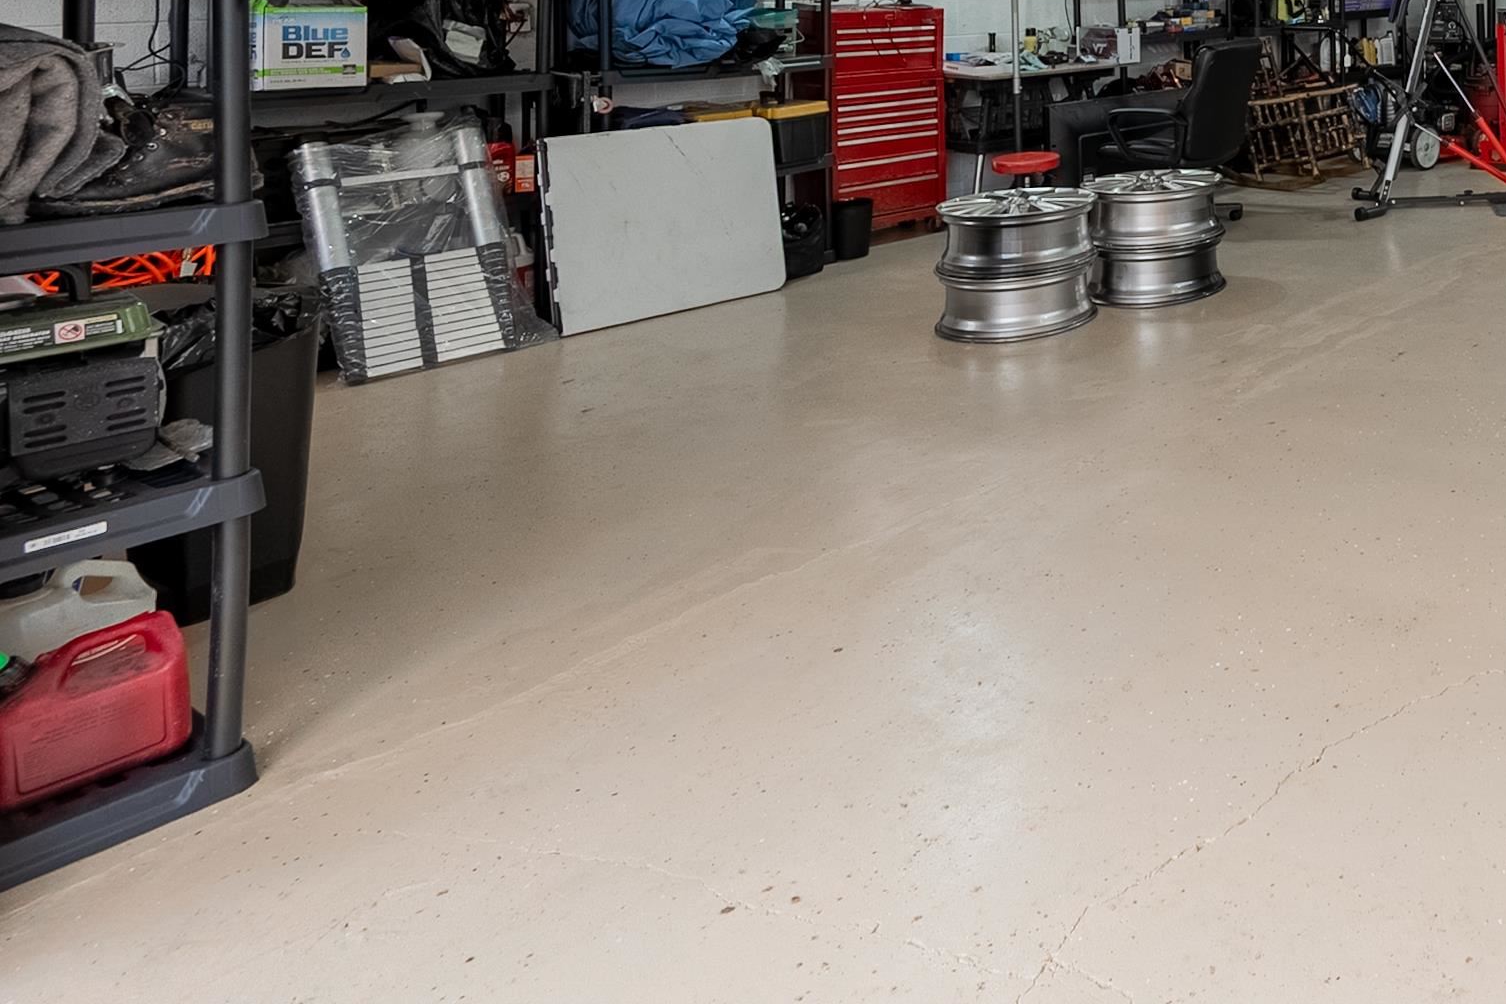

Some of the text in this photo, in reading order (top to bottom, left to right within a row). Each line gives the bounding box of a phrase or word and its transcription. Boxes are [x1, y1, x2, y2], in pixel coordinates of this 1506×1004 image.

[282, 25, 349, 42] Blue
[282, 42, 349, 60] DEF
[1092, 43, 1108, 55] VT
